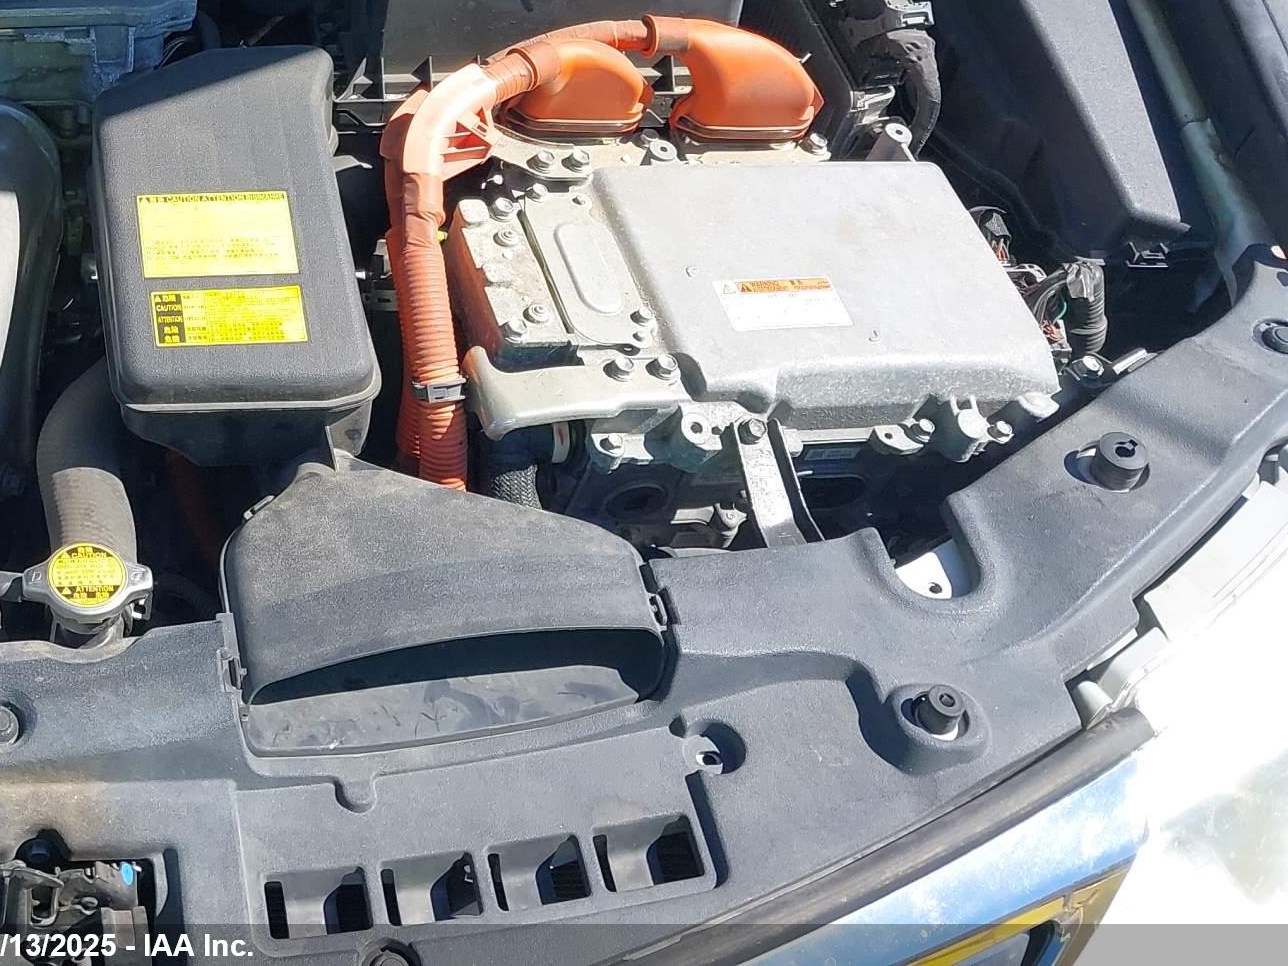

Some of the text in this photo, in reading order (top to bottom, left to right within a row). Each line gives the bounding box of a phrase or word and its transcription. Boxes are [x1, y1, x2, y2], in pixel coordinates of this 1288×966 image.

[156, 304, 182, 312] CAUTION
[157, 315, 184, 324] ATTENTION
[75, 585, 114, 593] ATTENTION
